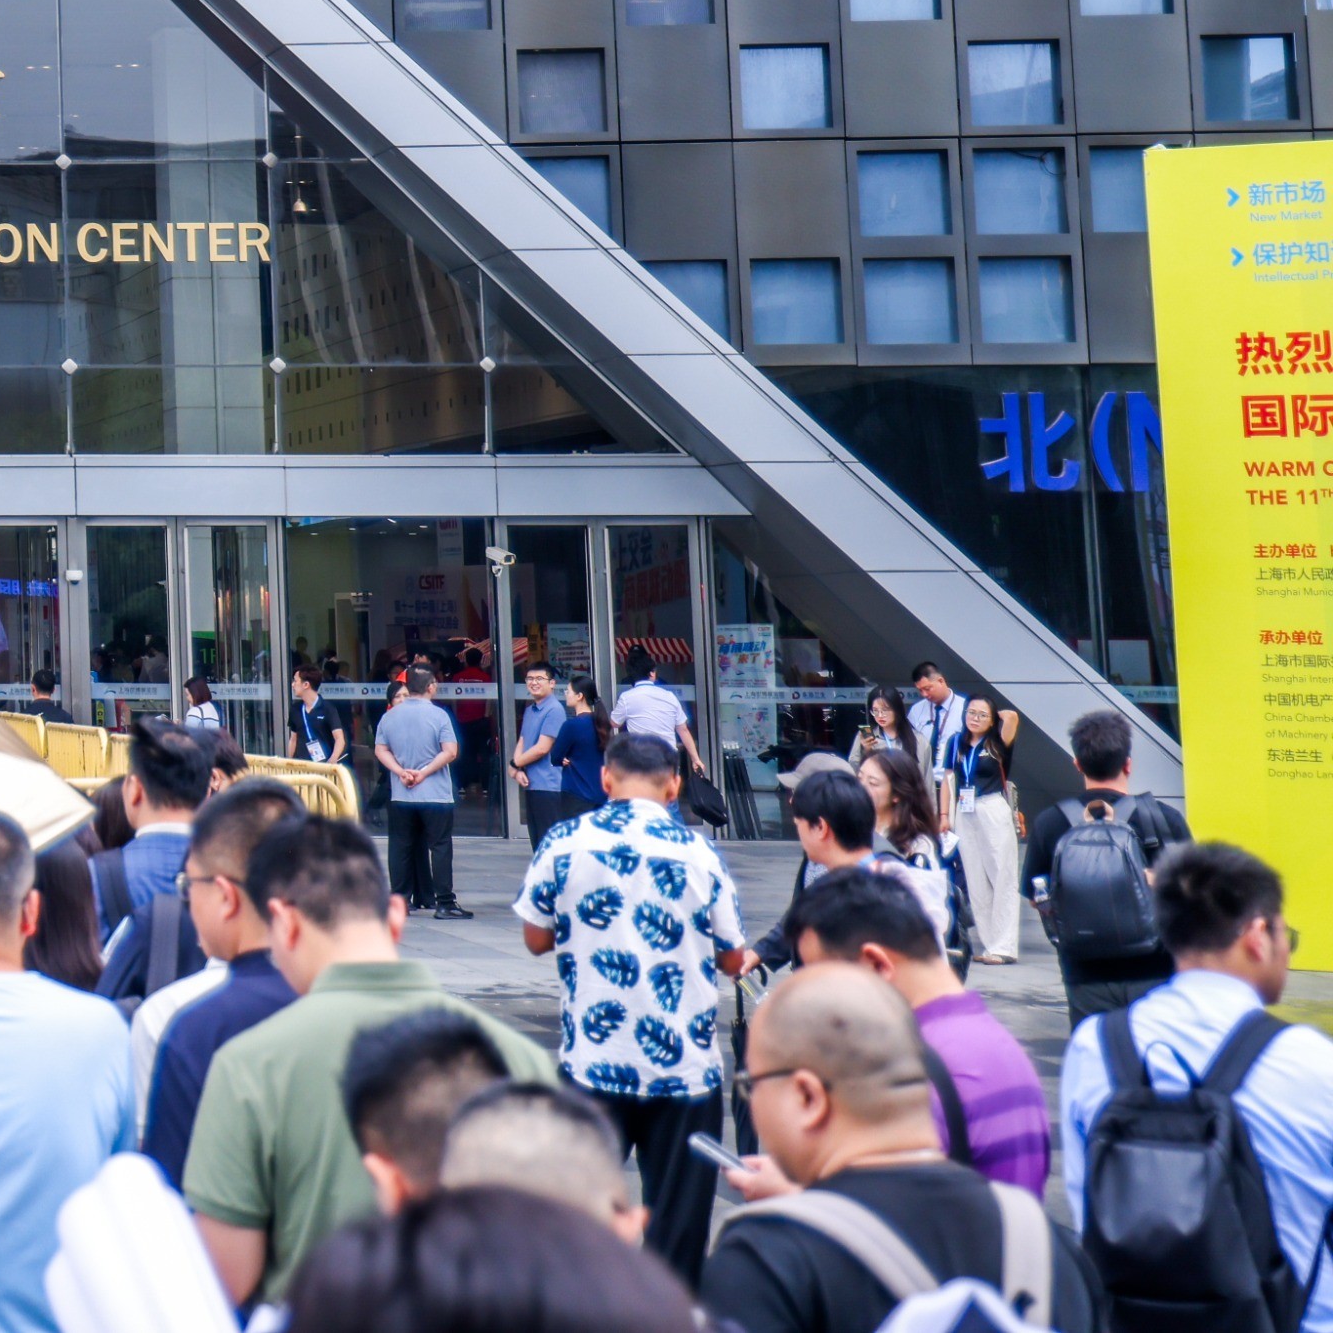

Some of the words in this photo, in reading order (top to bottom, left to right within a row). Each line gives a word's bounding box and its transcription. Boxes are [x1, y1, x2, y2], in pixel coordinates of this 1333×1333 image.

[1248, 180, 1325, 206] 新市场
[1250, 212, 1276, 222] New
[1280, 210, 1323, 220] Market
[78, 222, 270, 263] CENTER
[1254, 270, 1319, 282] Intellectual
[1235, 329, 1333, 377] 热烈
[1241, 394, 1333, 438] 国际
[1243, 461, 1315, 477] WARM
[1246, 489, 1288, 506] THE
[1253, 543, 1317, 559] 主办单位
[419, 574, 445, 590] CSITF
[1256, 586, 1301, 598] Shanghai
[1259, 630, 1323, 645] 承办单位
[1262, 674, 1307, 685] Shanghai
[1264, 712, 1293, 722] China
[1265, 729, 1276, 738] of
[1278, 729, 1328, 741] Machinery
[1267, 748, 1323, 763] 东浩兰生
[1268, 768, 1314, 780] Donghao
